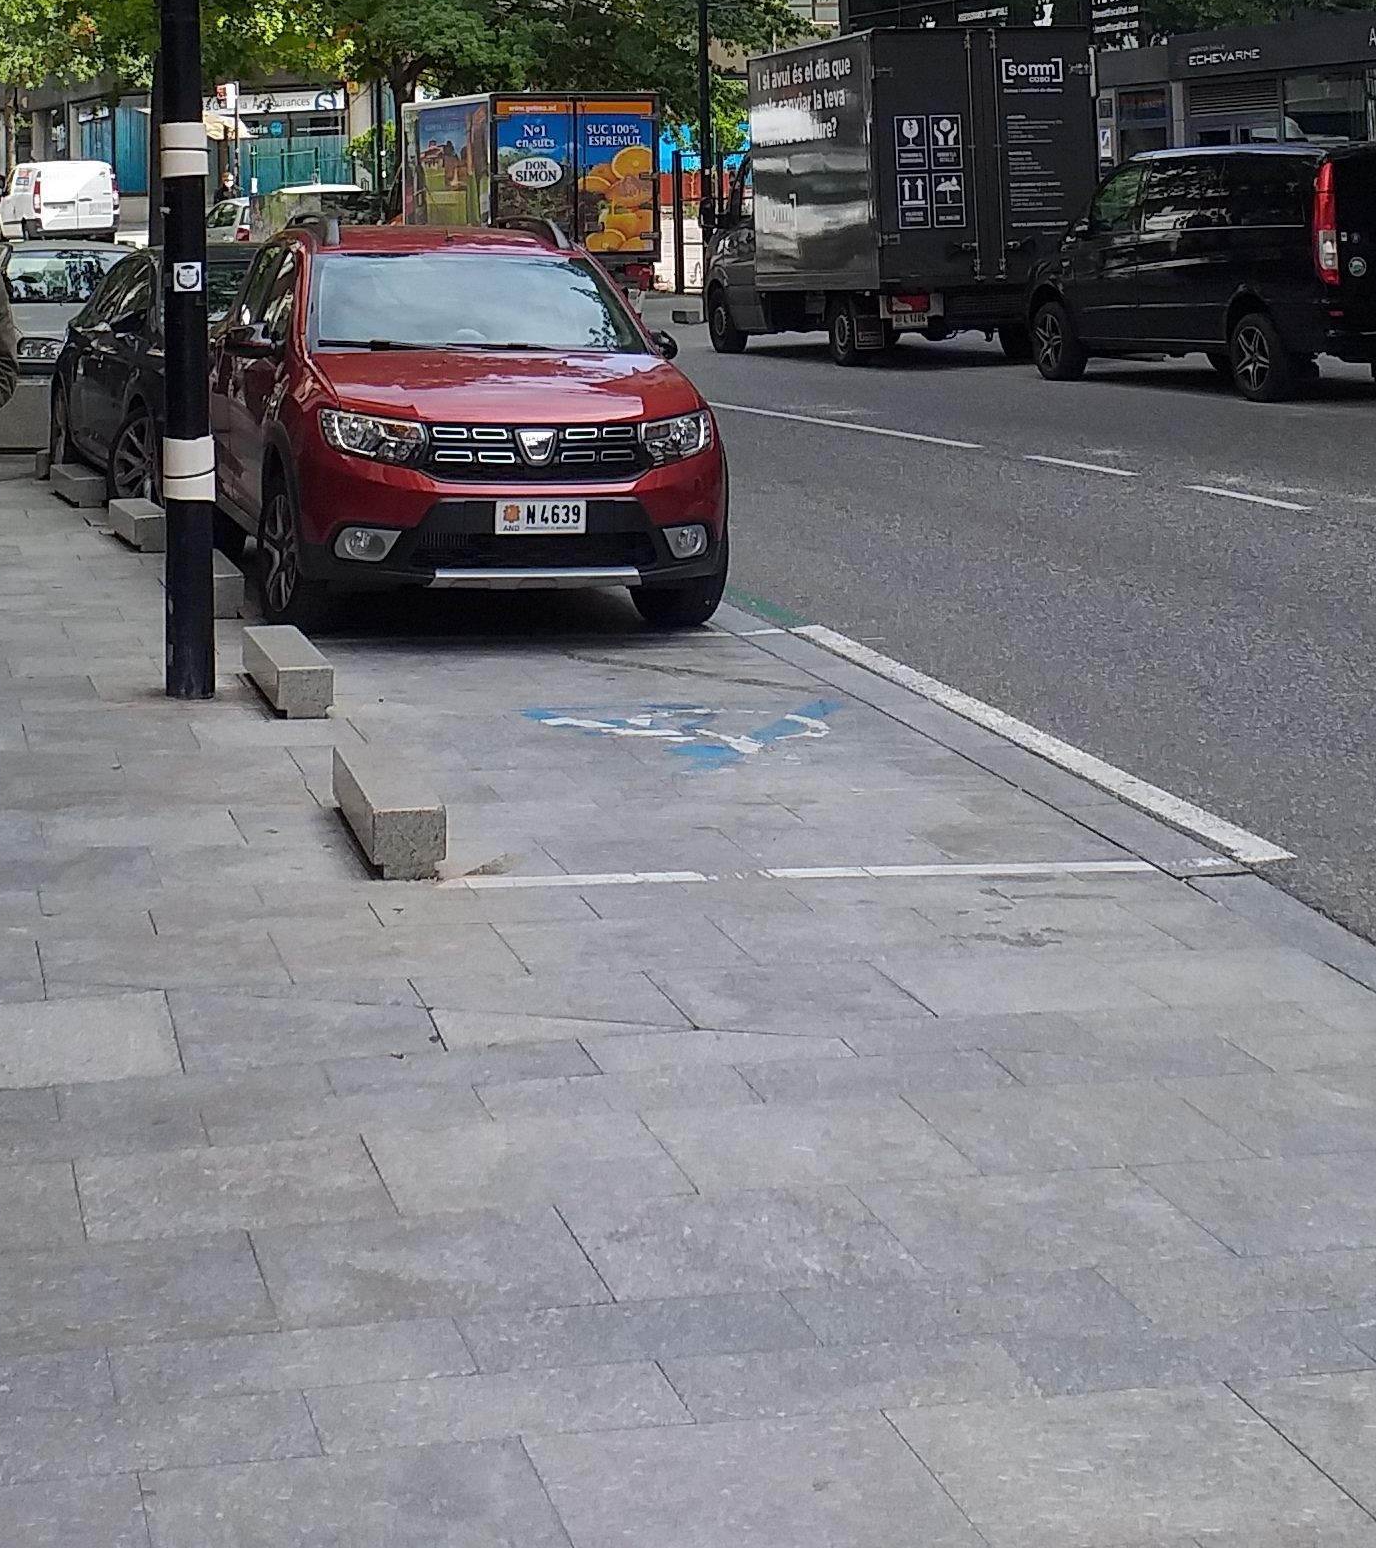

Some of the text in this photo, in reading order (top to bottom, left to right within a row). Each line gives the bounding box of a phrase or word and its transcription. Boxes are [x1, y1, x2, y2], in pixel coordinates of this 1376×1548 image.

[1188, 48, 1261, 66] ECHEVARNE
[762, 68, 771, 91] si
[771, 64, 791, 89] avui
[792, 62, 803, 85] és
[804, 59, 814, 83] el
[831, 56, 851, 81] que
[812, 88, 823, 111] la
[823, 87, 846, 109] teva
[586, 124, 640, 135] SUC 100%
[515, 138, 555, 148] en sucs
[588, 135, 641, 146] ESPREMUT
[525, 161, 547, 170] DON
[515, 170, 558, 182] SIMON
